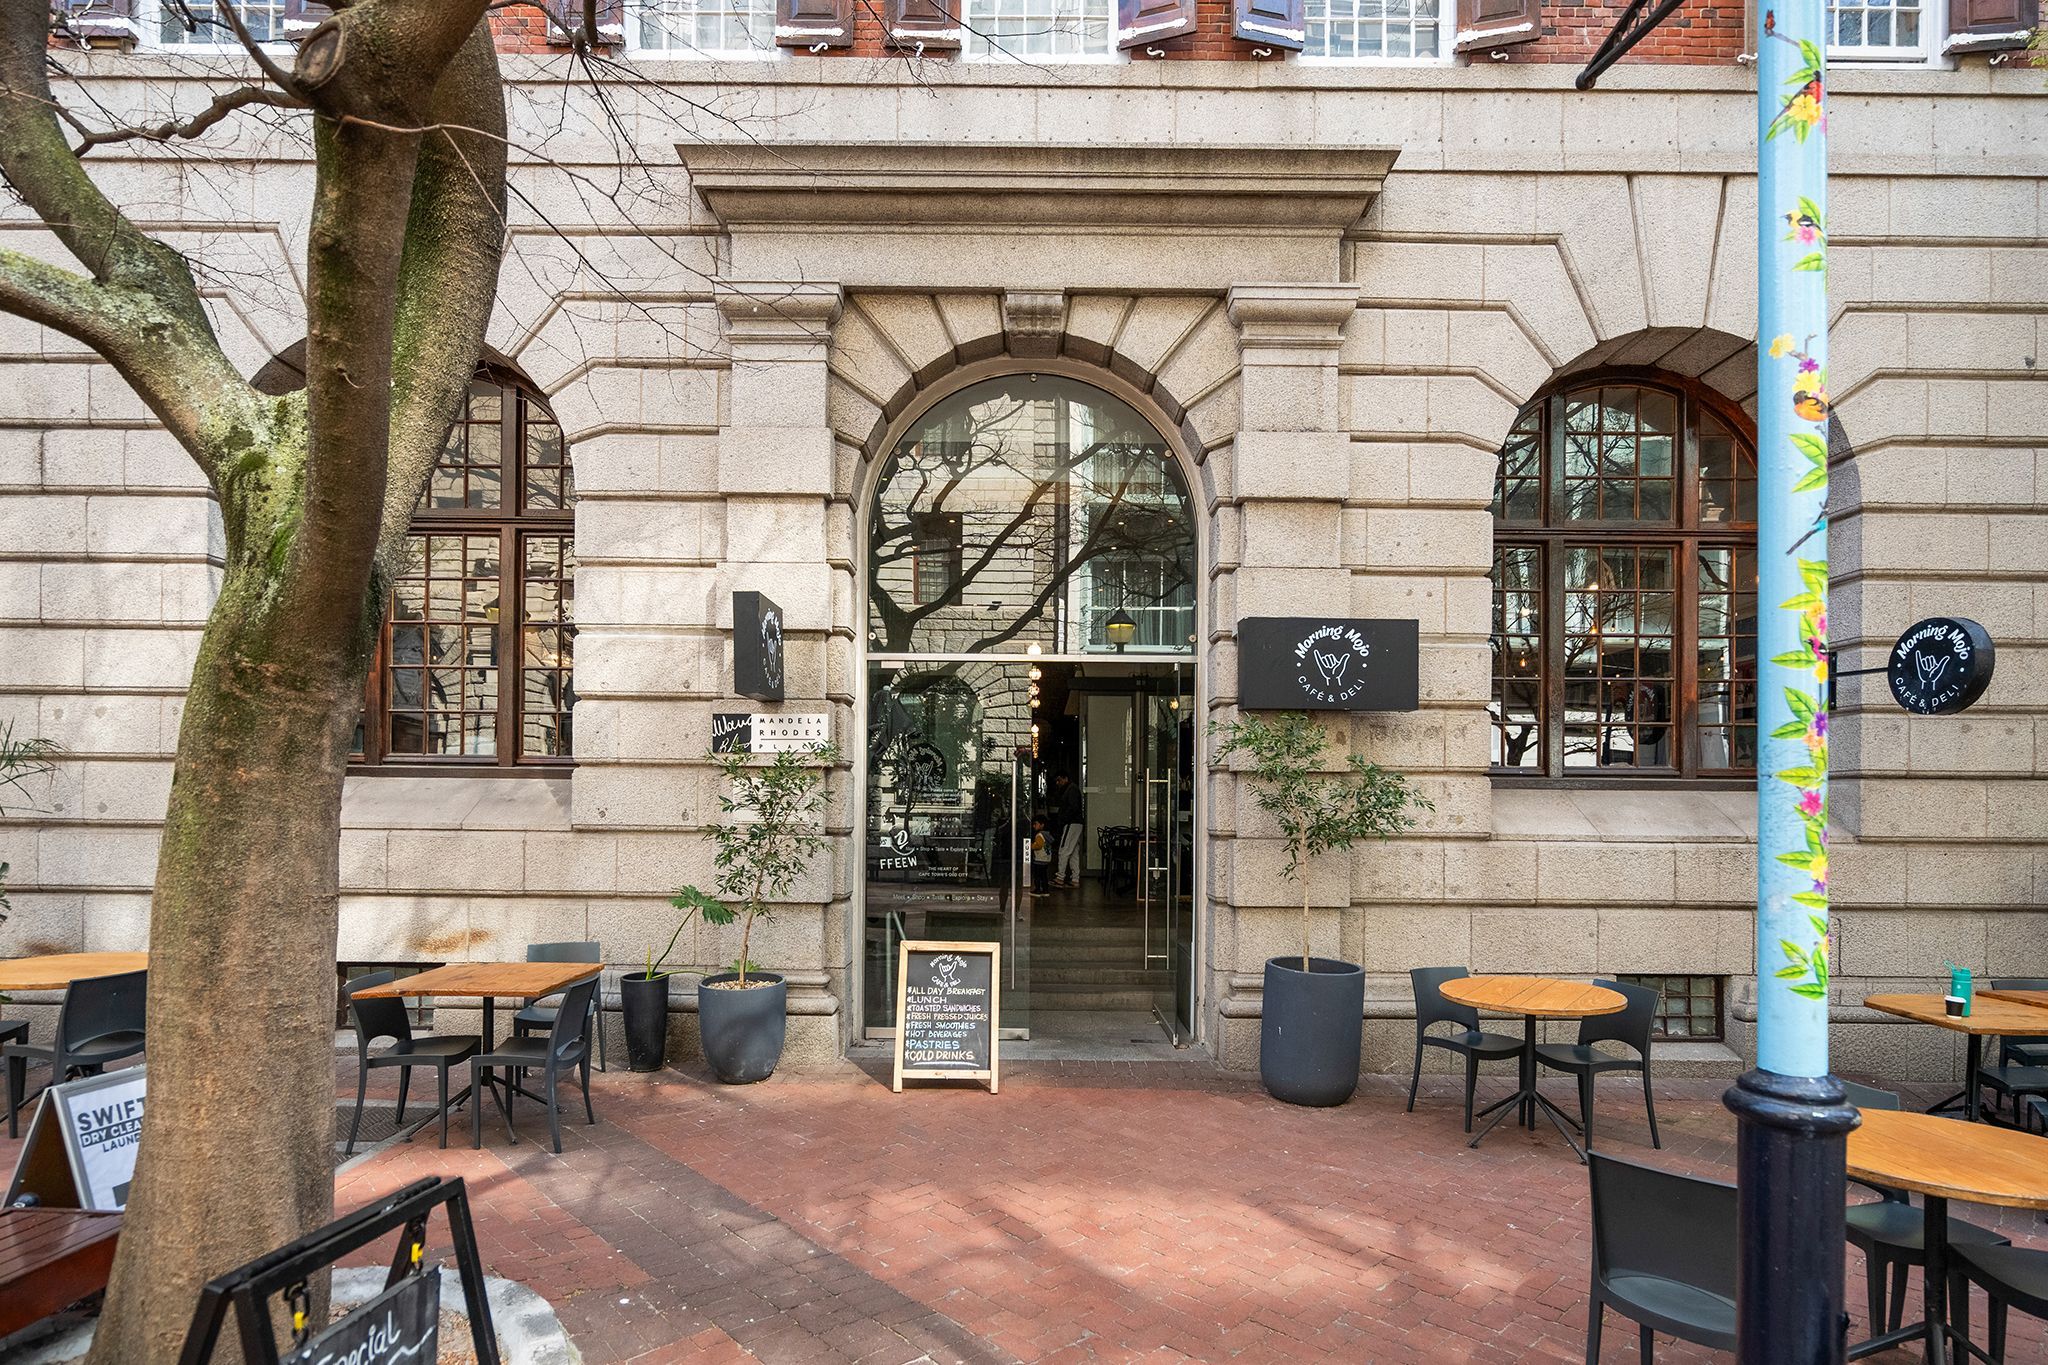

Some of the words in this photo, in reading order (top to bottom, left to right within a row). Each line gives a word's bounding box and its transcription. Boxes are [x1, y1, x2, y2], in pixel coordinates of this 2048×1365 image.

[1294, 625, 1343, 659] Morning
[1344, 628, 1370, 657] Mojo
[1896, 624, 1949, 660] Morning
[1947, 628, 1971, 660] Mojo
[1298, 675, 1324, 701] CAFÉ
[1327, 694, 1335, 702] &
[1340, 679, 1365, 700] DELI
[1895, 677, 1917, 704] CAFÉ
[1919, 699, 1926, 708] &
[1931, 684, 1959, 707] DELI
[929, 953, 954, 968] Morning
[954, 955, 968, 968] Mojo
[927, 987, 944, 996] DAY
[946, 988, 986, 996] BREAKFAST
[912, 996, 947, 1004] LUNCH
[912, 1004, 941, 1012] TOASTED
[964, 1013, 988, 1021] JUICES
[935, 1022, 976, 1030] SMOOTHIES
[910, 1030, 926, 1038] HOT
[928, 1030, 968, 1038] BEVERAGES
[910, 1040, 960, 1050] PASTRIES
[936, 1050, 975, 1060] DRINKS
[81, 1129, 107, 1146] DRY
